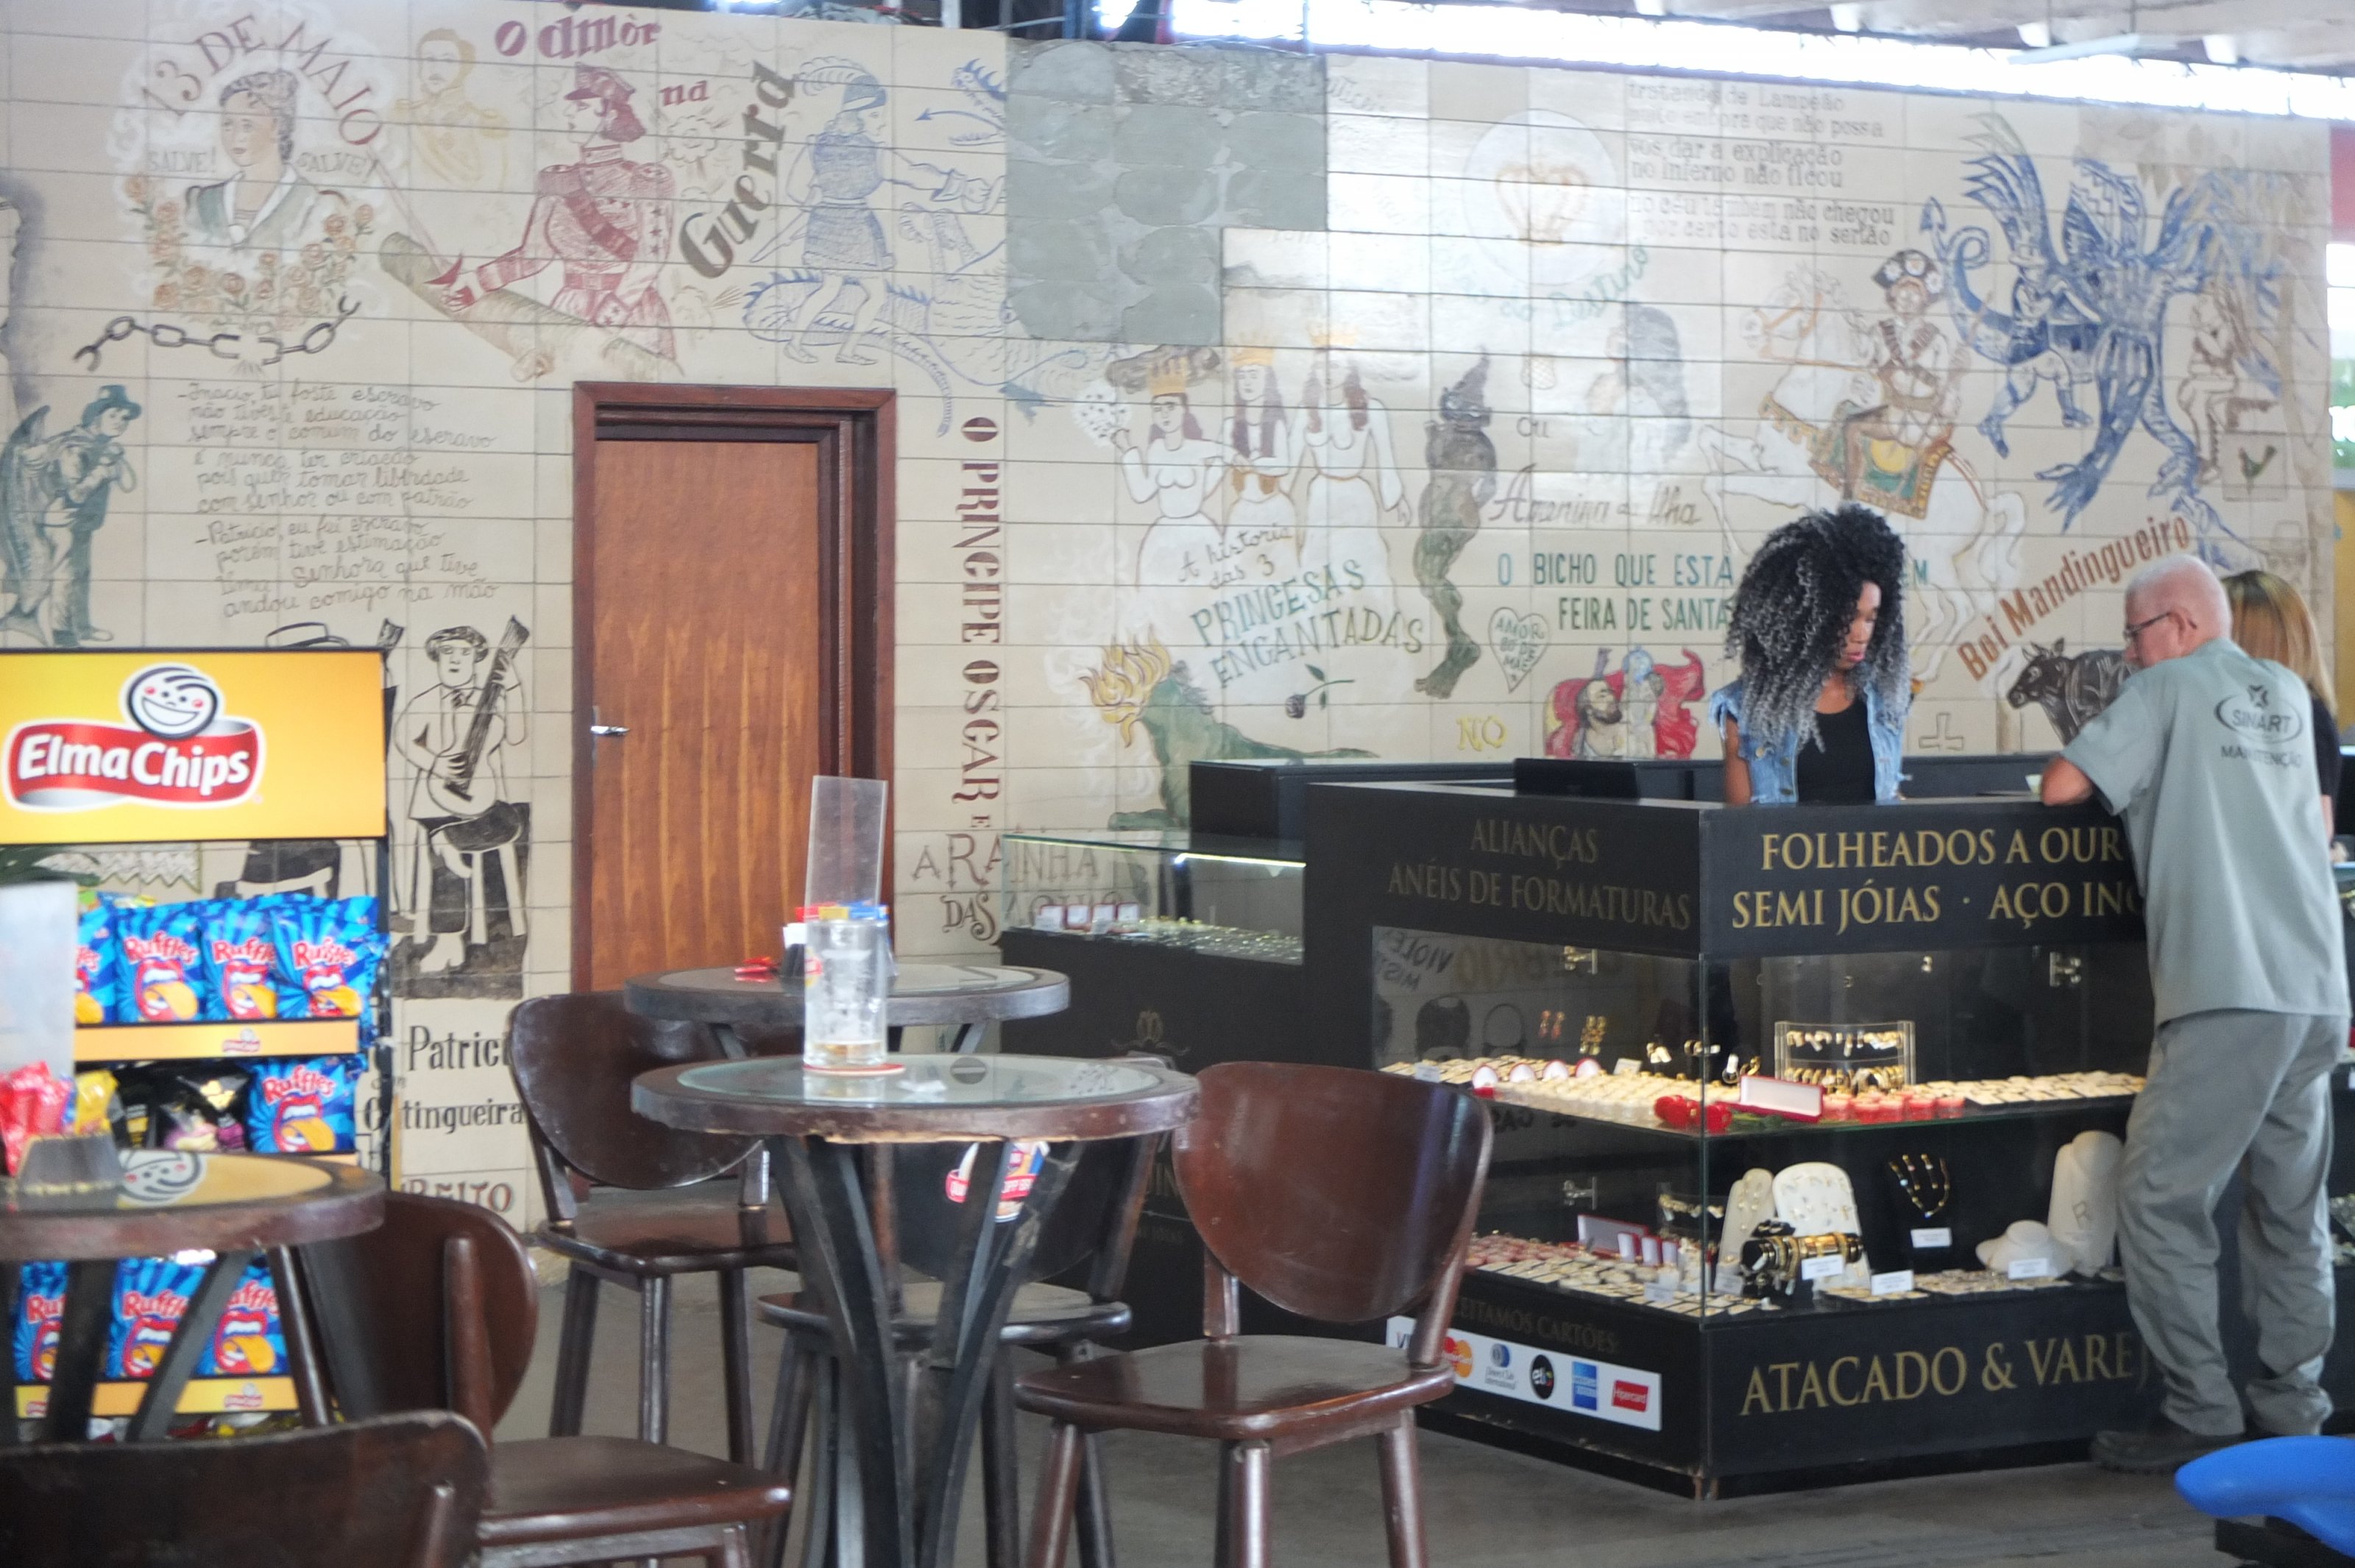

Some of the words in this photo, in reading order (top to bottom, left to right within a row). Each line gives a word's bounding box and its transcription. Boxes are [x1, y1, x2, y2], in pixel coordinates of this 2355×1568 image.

[141, 60, 202, 116] 13
[193, 13, 266, 75] DE
[277, 19, 383, 146] MAIO
[960, 416, 999, 442] O
[952, 461, 1000, 643] PRINCIPE
[1498, 553, 1513, 586] O
[1534, 553, 1596, 586] BICHO
[1615, 553, 1656, 587] QUE
[1559, 597, 1618, 631] FEIRA
[1626, 597, 1653, 631] DE
[1956, 614, 2010, 682] Boi
[2000, 515, 2191, 637] Mandingueiro
[952, 660, 1001, 803] OSCAR
[1469, 818, 1600, 869] ALIANÇAS
[1760, 829, 1997, 870] FOLHEADOS
[2005, 830, 2032, 865] A
[2039, 826, 2125, 864] OUR
[1388, 858, 1462, 902] ANÉIS
[1470, 871, 1504, 907] DE
[1511, 876, 1692, 932] FORMATURAS
[1731, 888, 1825, 929] SEMI
[1835, 879, 1942, 937] JÓIAS
[1989, 882, 2071, 929] AÇO
[263, 1064, 336, 1105] Ruffles
[364, 1098, 527, 1135] Ctingueira
[1738, 1345, 1968, 1416] ATACADO
[1980, 1343, 2017, 1391] &
